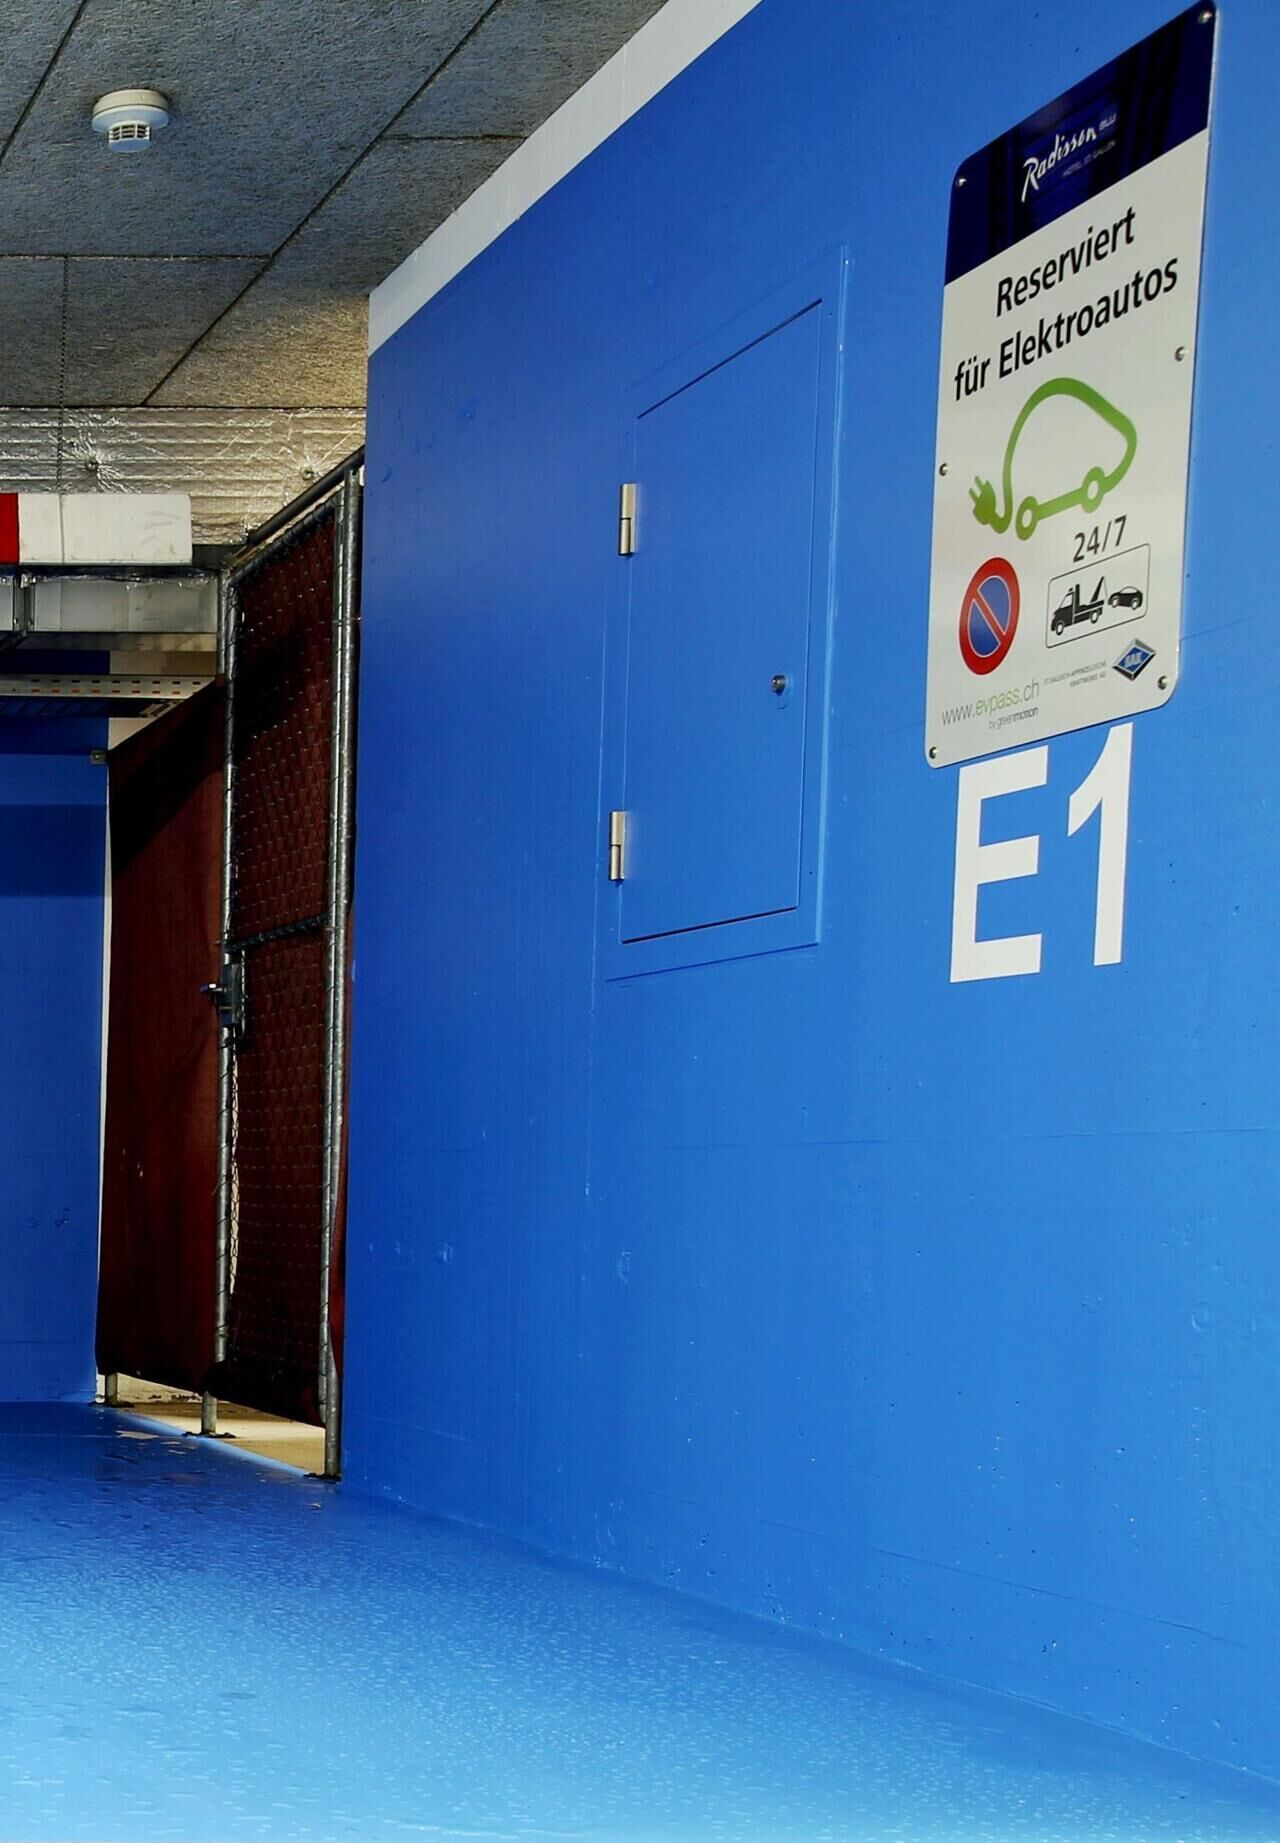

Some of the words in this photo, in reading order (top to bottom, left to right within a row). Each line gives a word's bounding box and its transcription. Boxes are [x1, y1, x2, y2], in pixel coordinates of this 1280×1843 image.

[1021, 127, 1097, 203] Radisson
[996, 206, 1136, 318] Reserviert
[954, 355, 991, 401] für
[998, 257, 1179, 379] Elektroautos
[1073, 514, 1127, 563] 24/7
[941, 679, 1040, 727] www.evpass.ch
[949, 721, 1134, 984] E1
